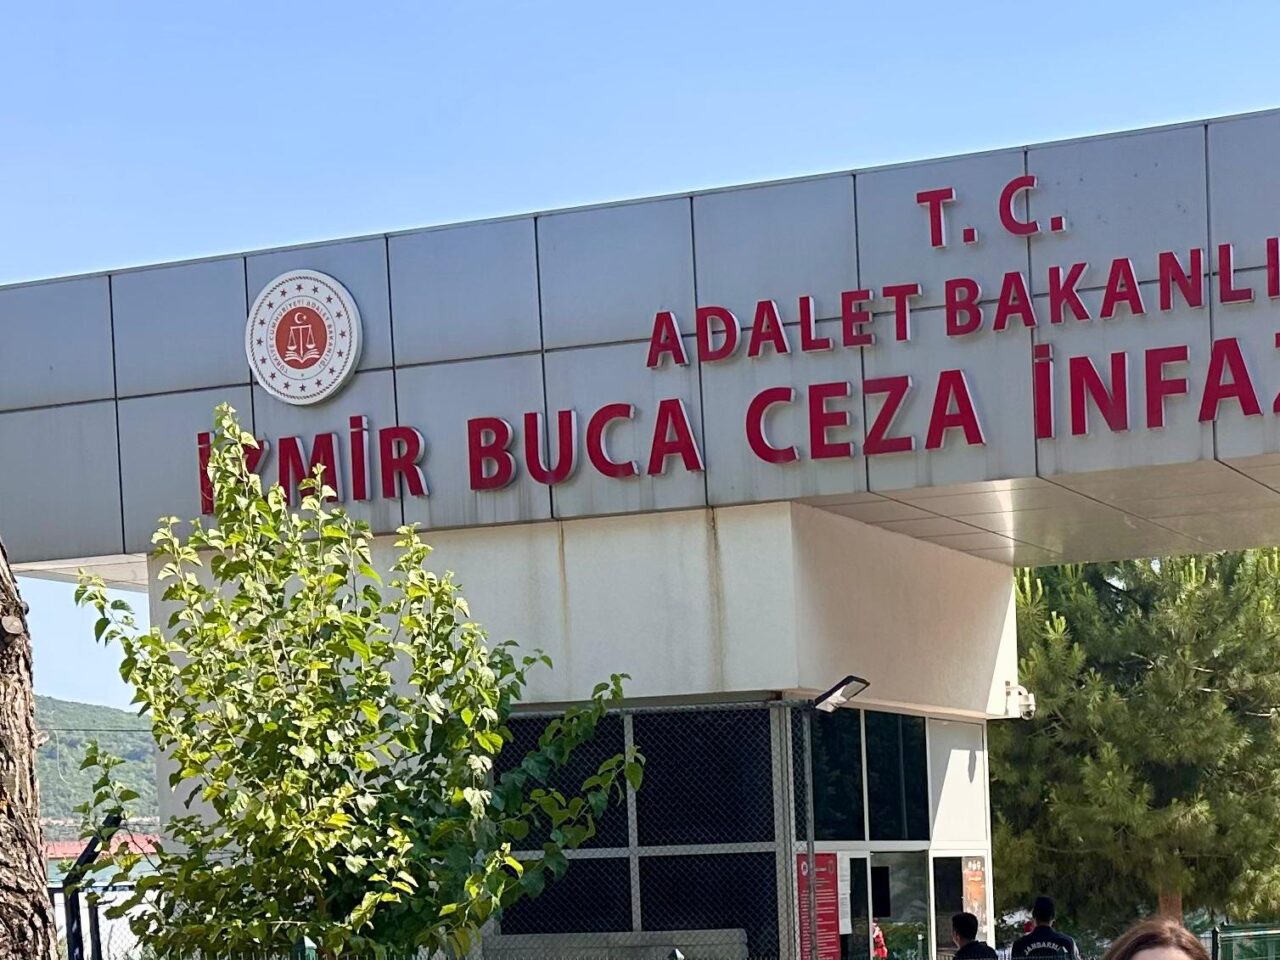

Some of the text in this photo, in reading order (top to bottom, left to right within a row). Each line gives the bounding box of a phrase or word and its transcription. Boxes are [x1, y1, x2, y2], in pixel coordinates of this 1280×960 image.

[915, 174, 1066, 248] T. C.
[646, 284, 922, 368] ADALET
[467, 403, 705, 491] BUCA
[745, 369, 986, 465] CEZA
